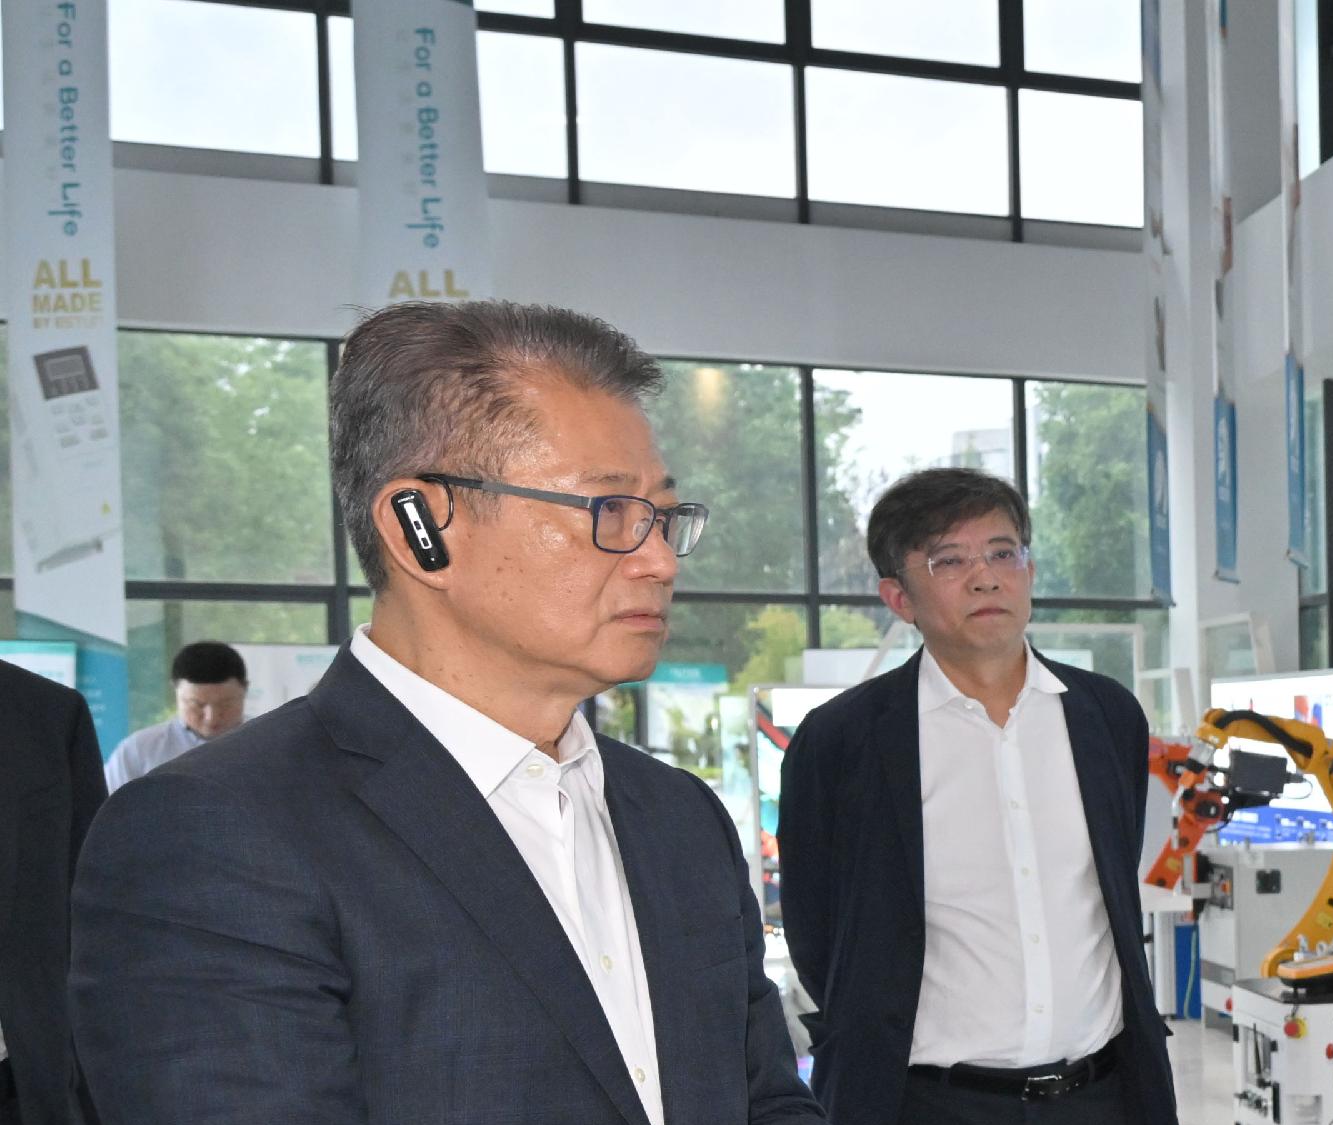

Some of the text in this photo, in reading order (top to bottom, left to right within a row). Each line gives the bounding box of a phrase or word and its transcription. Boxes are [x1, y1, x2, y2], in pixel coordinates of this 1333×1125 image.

[414, 27, 436, 71] For
[415, 81, 433, 98] a
[48, 3, 82, 236] For a Better Life
[415, 107, 440, 187] Better
[405, 197, 444, 249] Life
[33, 257, 103, 289] ALL
[388, 267, 470, 299] ALL
[32, 292, 102, 313] MADE
